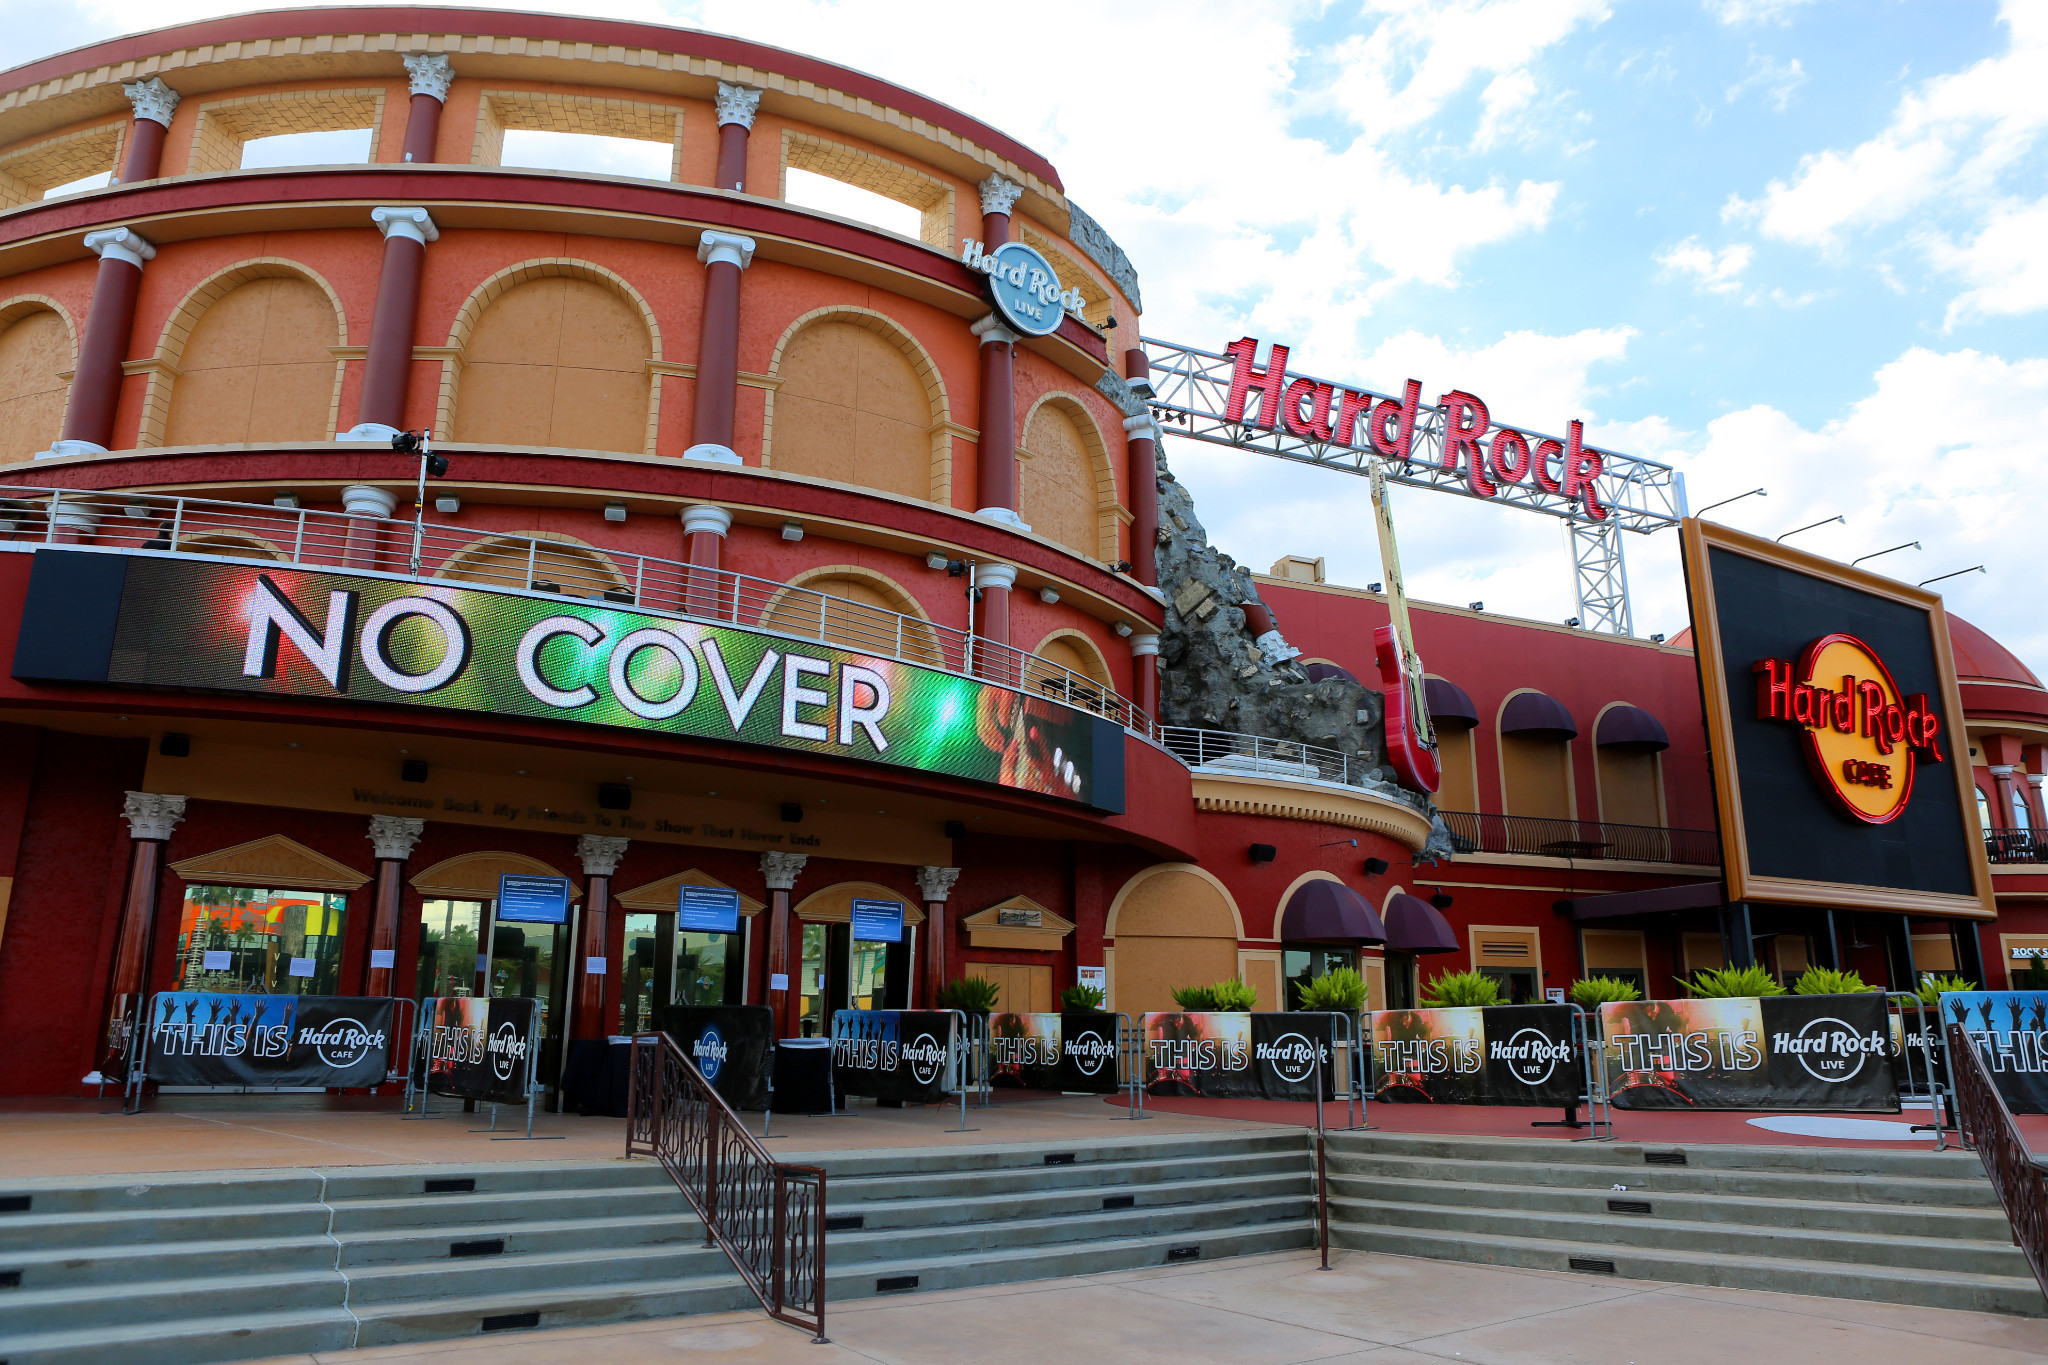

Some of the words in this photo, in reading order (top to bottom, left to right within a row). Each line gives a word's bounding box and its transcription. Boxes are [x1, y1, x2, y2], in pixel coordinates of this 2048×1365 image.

[962, 237, 1028, 289] Hard
[1028, 267, 1086, 321] Rock
[1014, 298, 1043, 322] LIVE
[1223, 336, 1422, 461] Hard
[1437, 389, 1606, 521] Rock
[242, 573, 472, 693] NO
[516, 614, 892, 753] COVER
[1753, 657, 1856, 734] Hard
[1857, 679, 1946, 765] Rock
[1842, 758, 1894, 789] CAFE
[352, 788, 434, 810] Welcome
[443, 797, 484, 815] Back
[493, 802, 520, 821] My
[528, 805, 587, 825] Friends
[594, 812, 612, 827] To
[619, 815, 647, 831] The
[654, 818, 694, 835] Show
[702, 822, 734, 839] That
[741, 827, 784, 844] Never
[789, 832, 821, 848] Ends
[2011, 947, 2040, 956] ROCK
[160, 1022, 247, 1057] THIS
[253, 1024, 288, 1058] IS
[299, 1027, 345, 1047] Hard
[344, 1028, 386, 1050] Rock
[432, 1025, 469, 1063] THIS
[468, 1028, 485, 1065] IS
[487, 1032, 508, 1054] Hard
[506, 1034, 526, 1060] Rock
[692, 1039, 710, 1058] Hard
[709, 1041, 728, 1063] Rock
[993, 1037, 1037, 1065] THIS
[1040, 1037, 1060, 1066] IS
[1064, 1039, 1089, 1056] Hard
[1090, 1040, 1115, 1059] Rock
[1256, 1042, 1293, 1061] Hard
[1490, 1040, 1528, 1060] Hard
[1530, 1040, 1571, 1063] Rock
[1611, 1032, 1713, 1072] THIS
[1718, 1031, 1762, 1071] IS
[1772, 1031, 1827, 1054] Hard
[1829, 1030, 1885, 1058] Rock
[330, 1050, 354, 1060] CAFE
[499, 1060, 509, 1070] LIVE
[836, 1037, 878, 1070] THIS
[880, 1039, 898, 1072] IS
[902, 1043, 925, 1061] Hard
[925, 1044, 948, 1066] Rock
[1150, 1039, 1217, 1071] THIS
[1221, 1040, 1249, 1072] IS
[1378, 1039, 1449, 1074] THIS
[1453, 1039, 1482, 1074] IS
[1820, 1060, 1845, 1070] LIVE
[918, 1066, 932, 1075] CAFE
[1285, 1065, 1302, 1073] LIVE
[1523, 1065, 1541, 1074] LIVE
